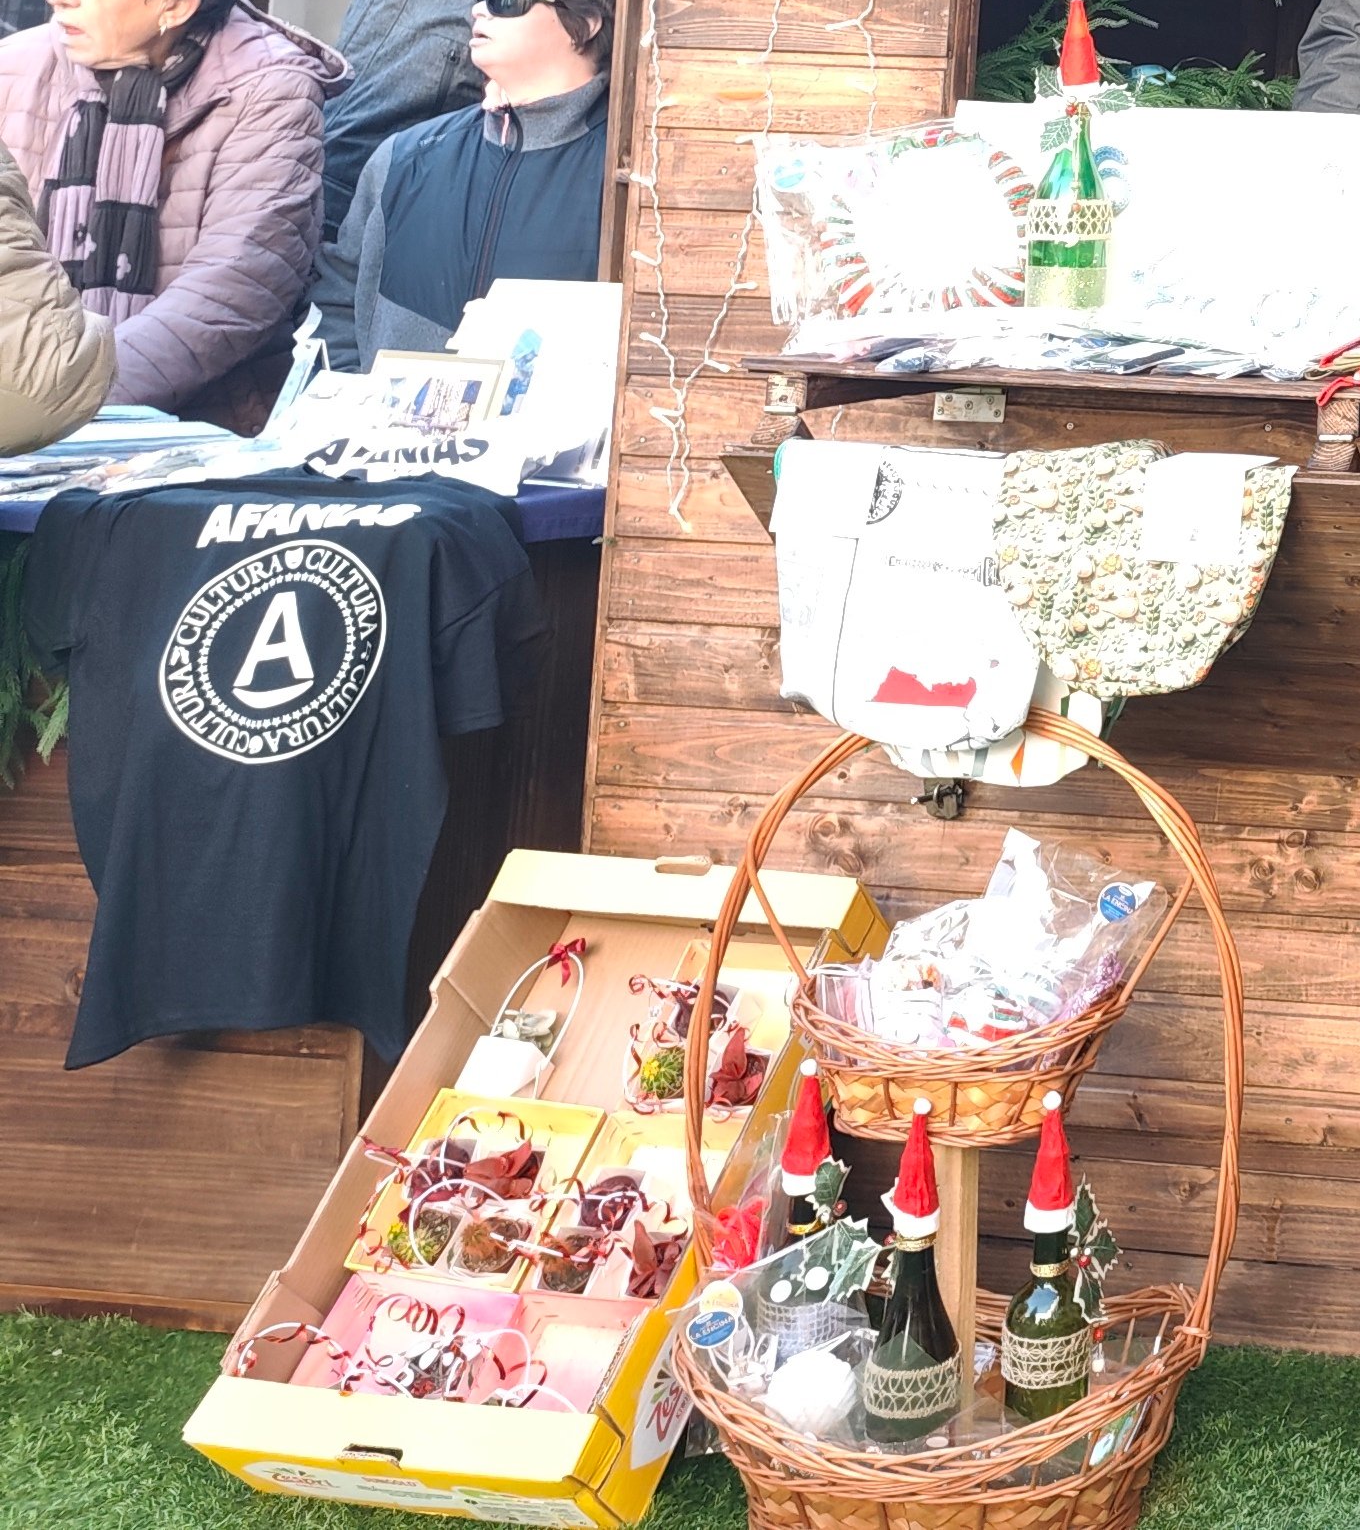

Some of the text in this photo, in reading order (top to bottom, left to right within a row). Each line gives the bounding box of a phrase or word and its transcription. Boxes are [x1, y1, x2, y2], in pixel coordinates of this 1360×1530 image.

[195, 503, 422, 549] AFANIAS
[176, 554, 283, 646] CULTURA
[305, 548, 378, 641] CULTURA
[167, 662, 250, 753] CULTURA
[262, 663, 366, 754] CULTURA
